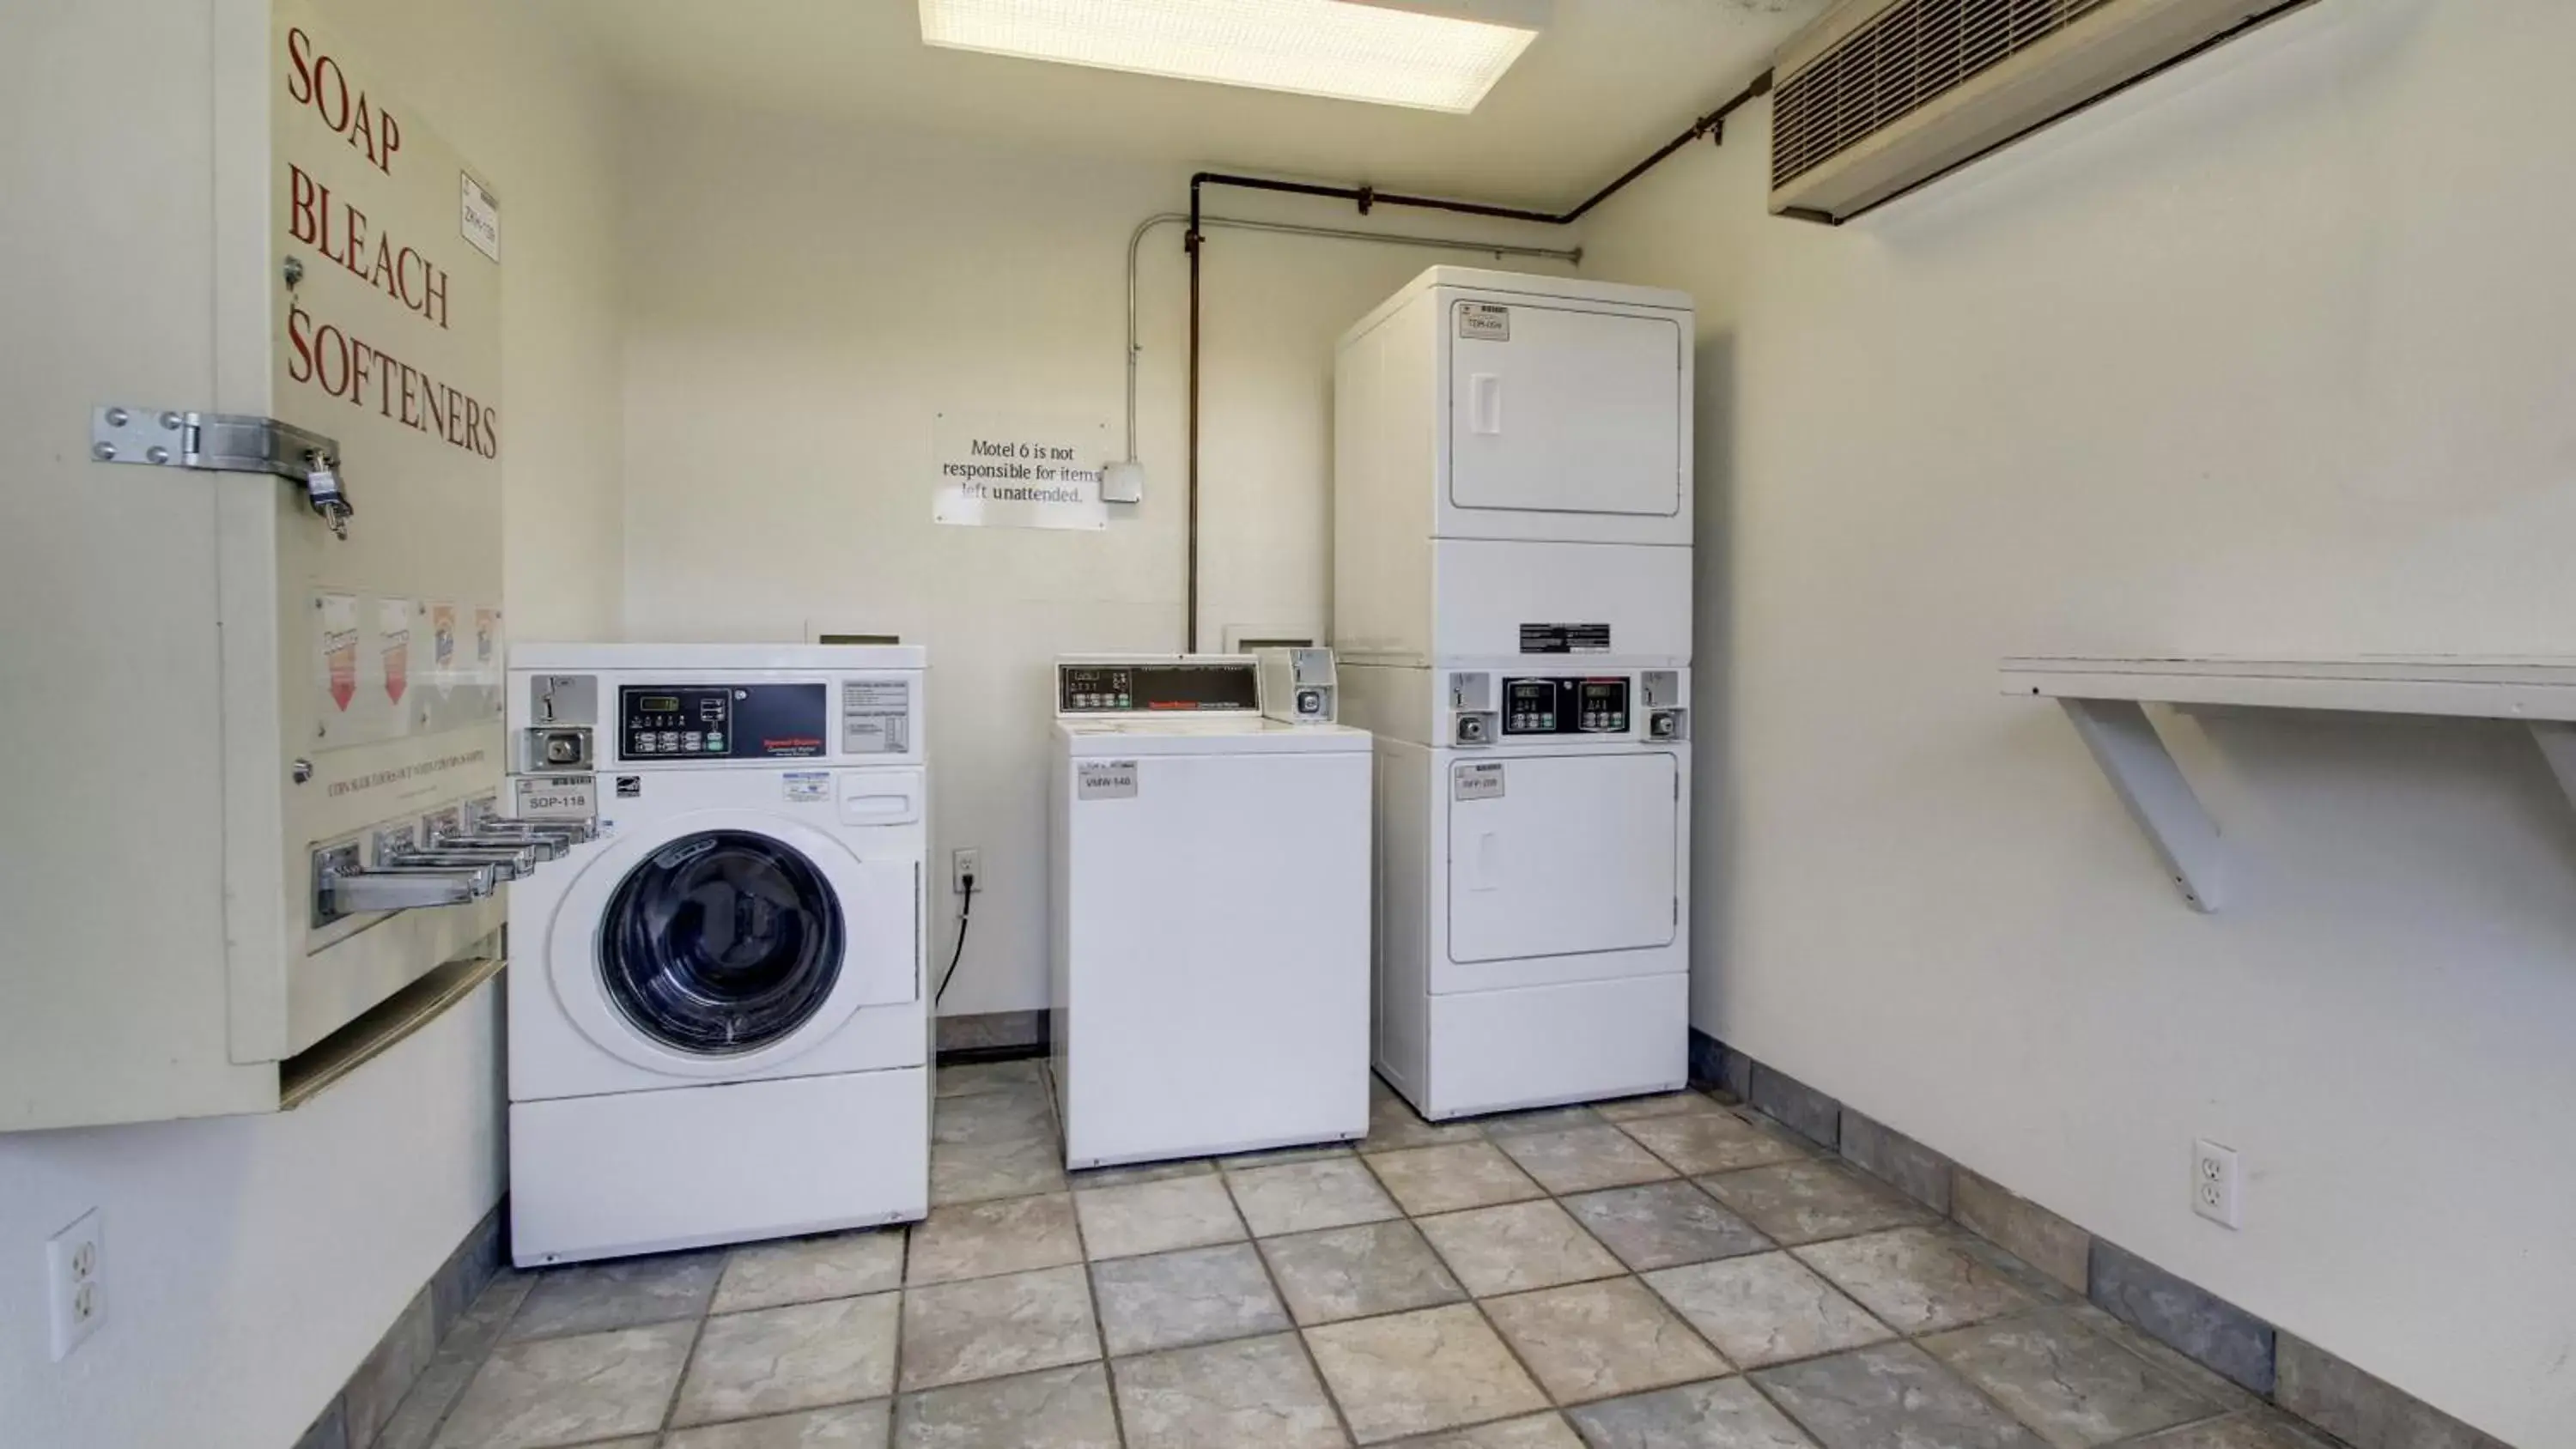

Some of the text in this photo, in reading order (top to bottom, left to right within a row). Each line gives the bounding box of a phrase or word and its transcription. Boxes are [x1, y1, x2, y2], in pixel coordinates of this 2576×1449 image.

[288, 27, 399, 176] SOAP
[289, 162, 448, 330] BLEACH
[289, 306, 496, 459] SOFTENERS
[944, 463, 1101, 482] responsible for items
[963, 482, 1082, 503] left unattended.
[971, 440, 1075, 461] Motel 6 is not
